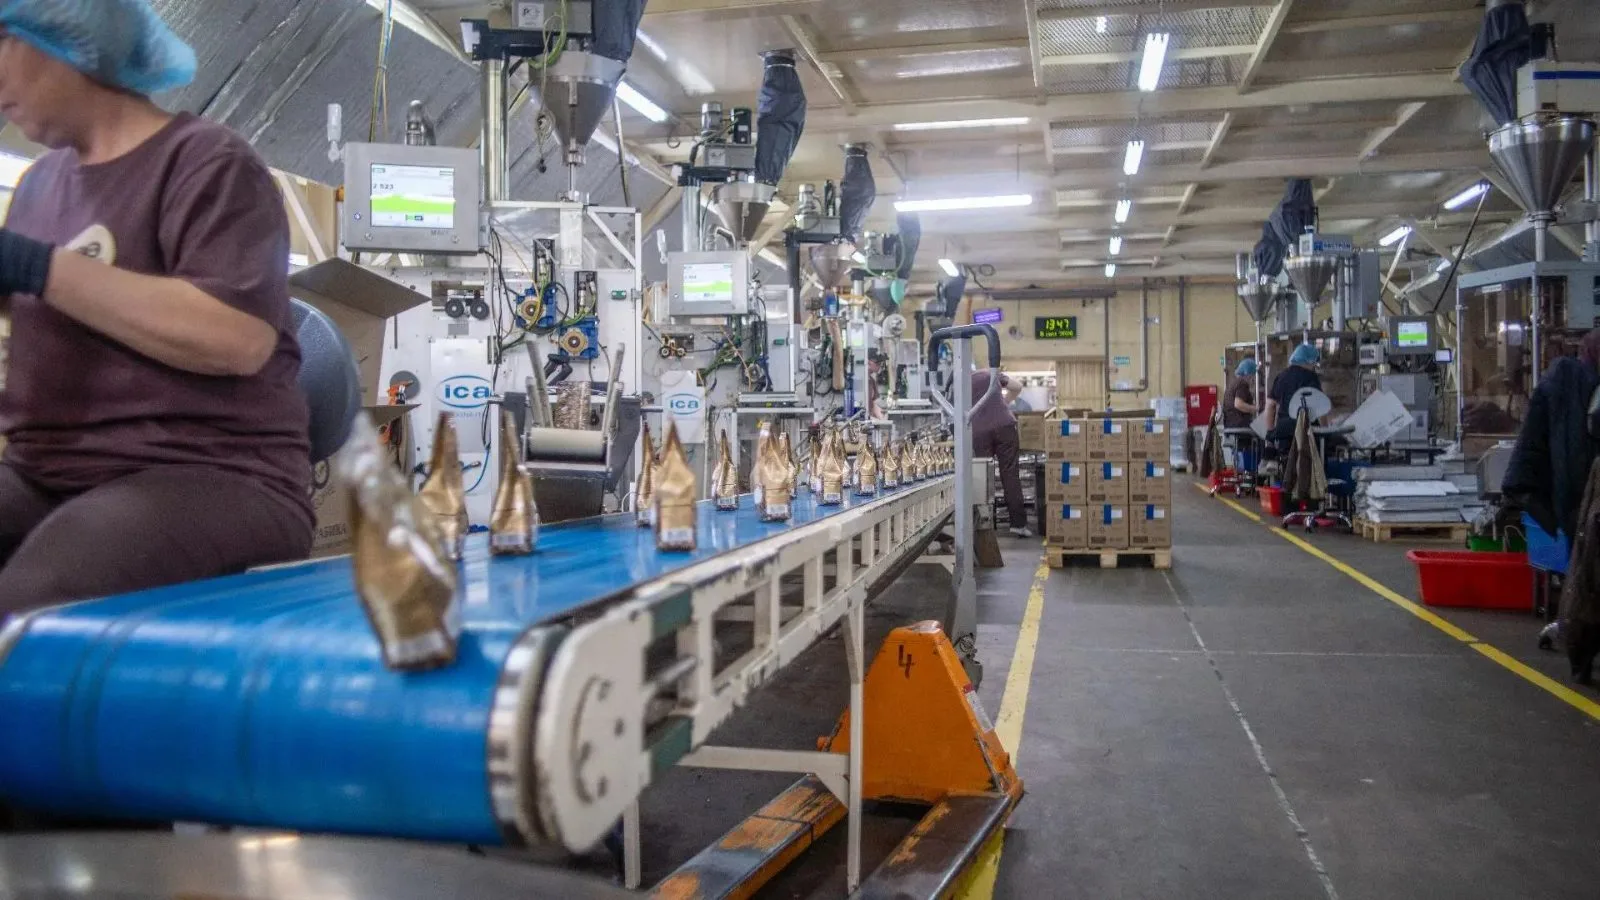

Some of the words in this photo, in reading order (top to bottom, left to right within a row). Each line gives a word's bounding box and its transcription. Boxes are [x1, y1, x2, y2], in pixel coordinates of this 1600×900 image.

[445, 384, 490, 399] ica
[670, 399, 698, 409] ica
[898, 644, 915, 680] 4
